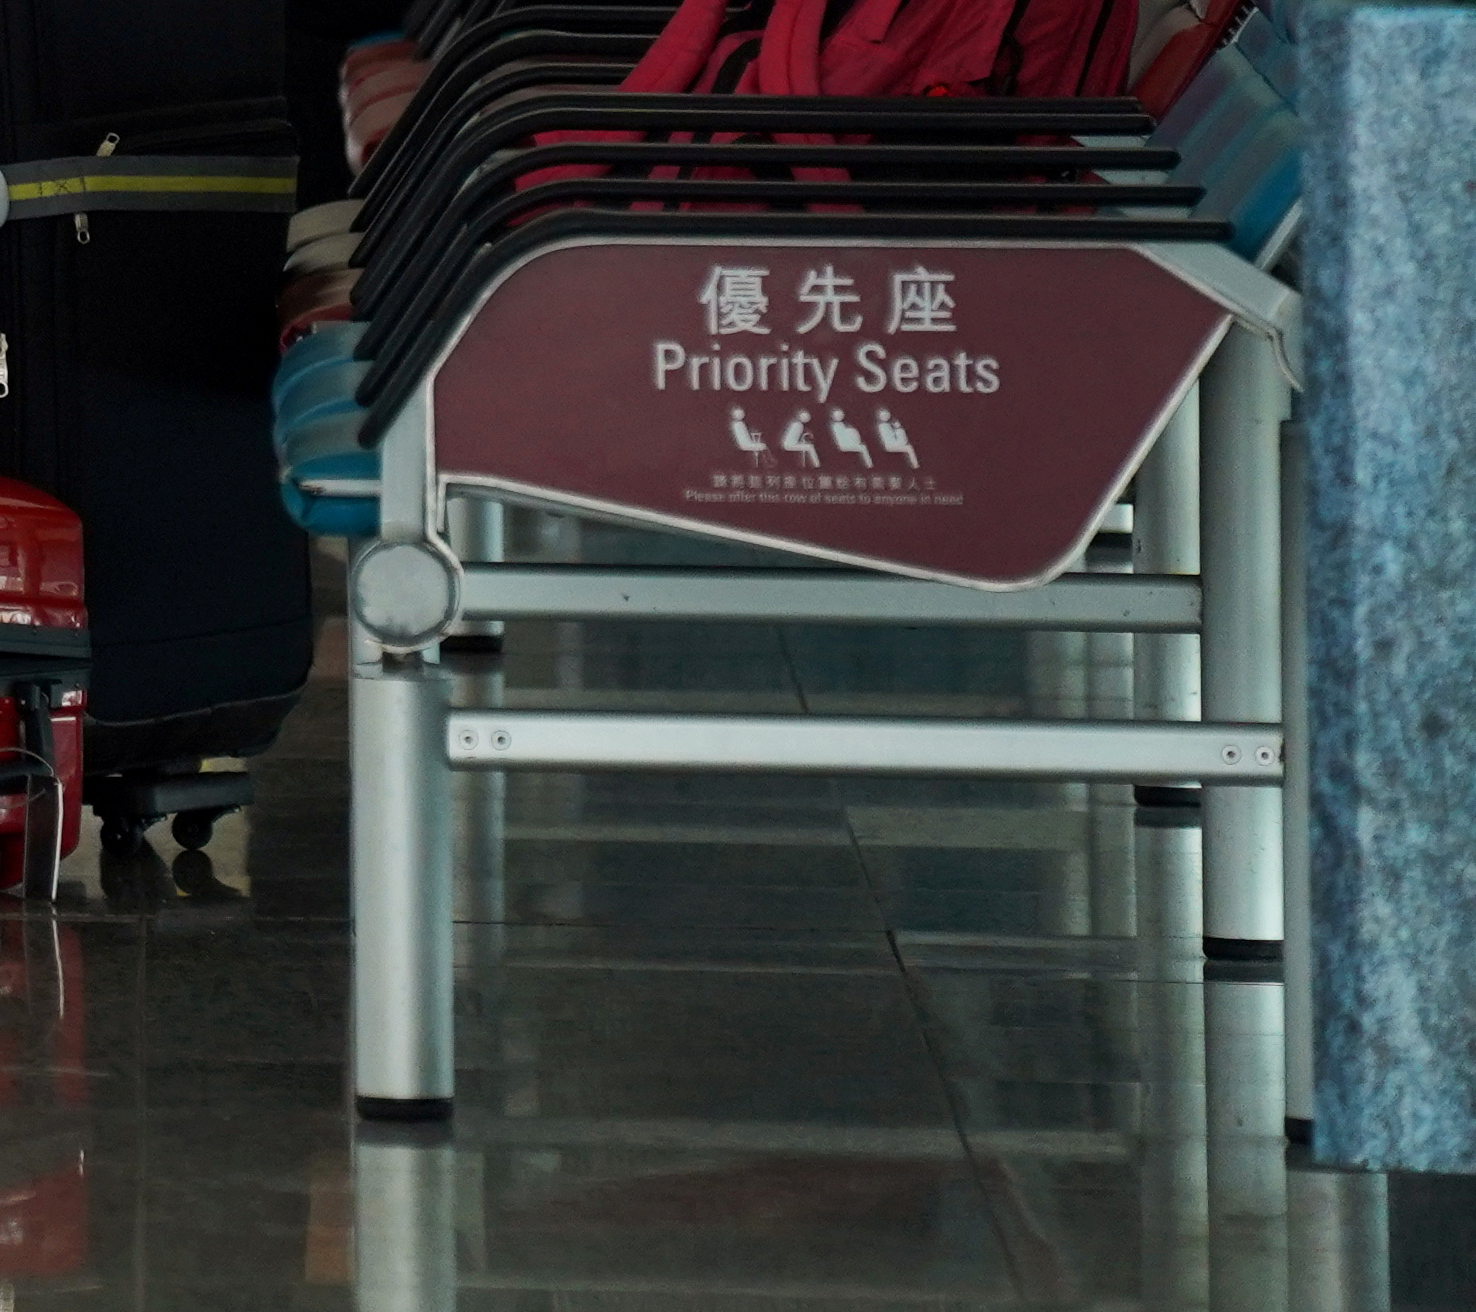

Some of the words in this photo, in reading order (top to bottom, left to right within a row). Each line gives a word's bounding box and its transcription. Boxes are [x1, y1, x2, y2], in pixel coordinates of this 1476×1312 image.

[699, 265, 957, 335] 優先座
[653, 341, 839, 403] Priority
[855, 342, 1000, 393] Seats
